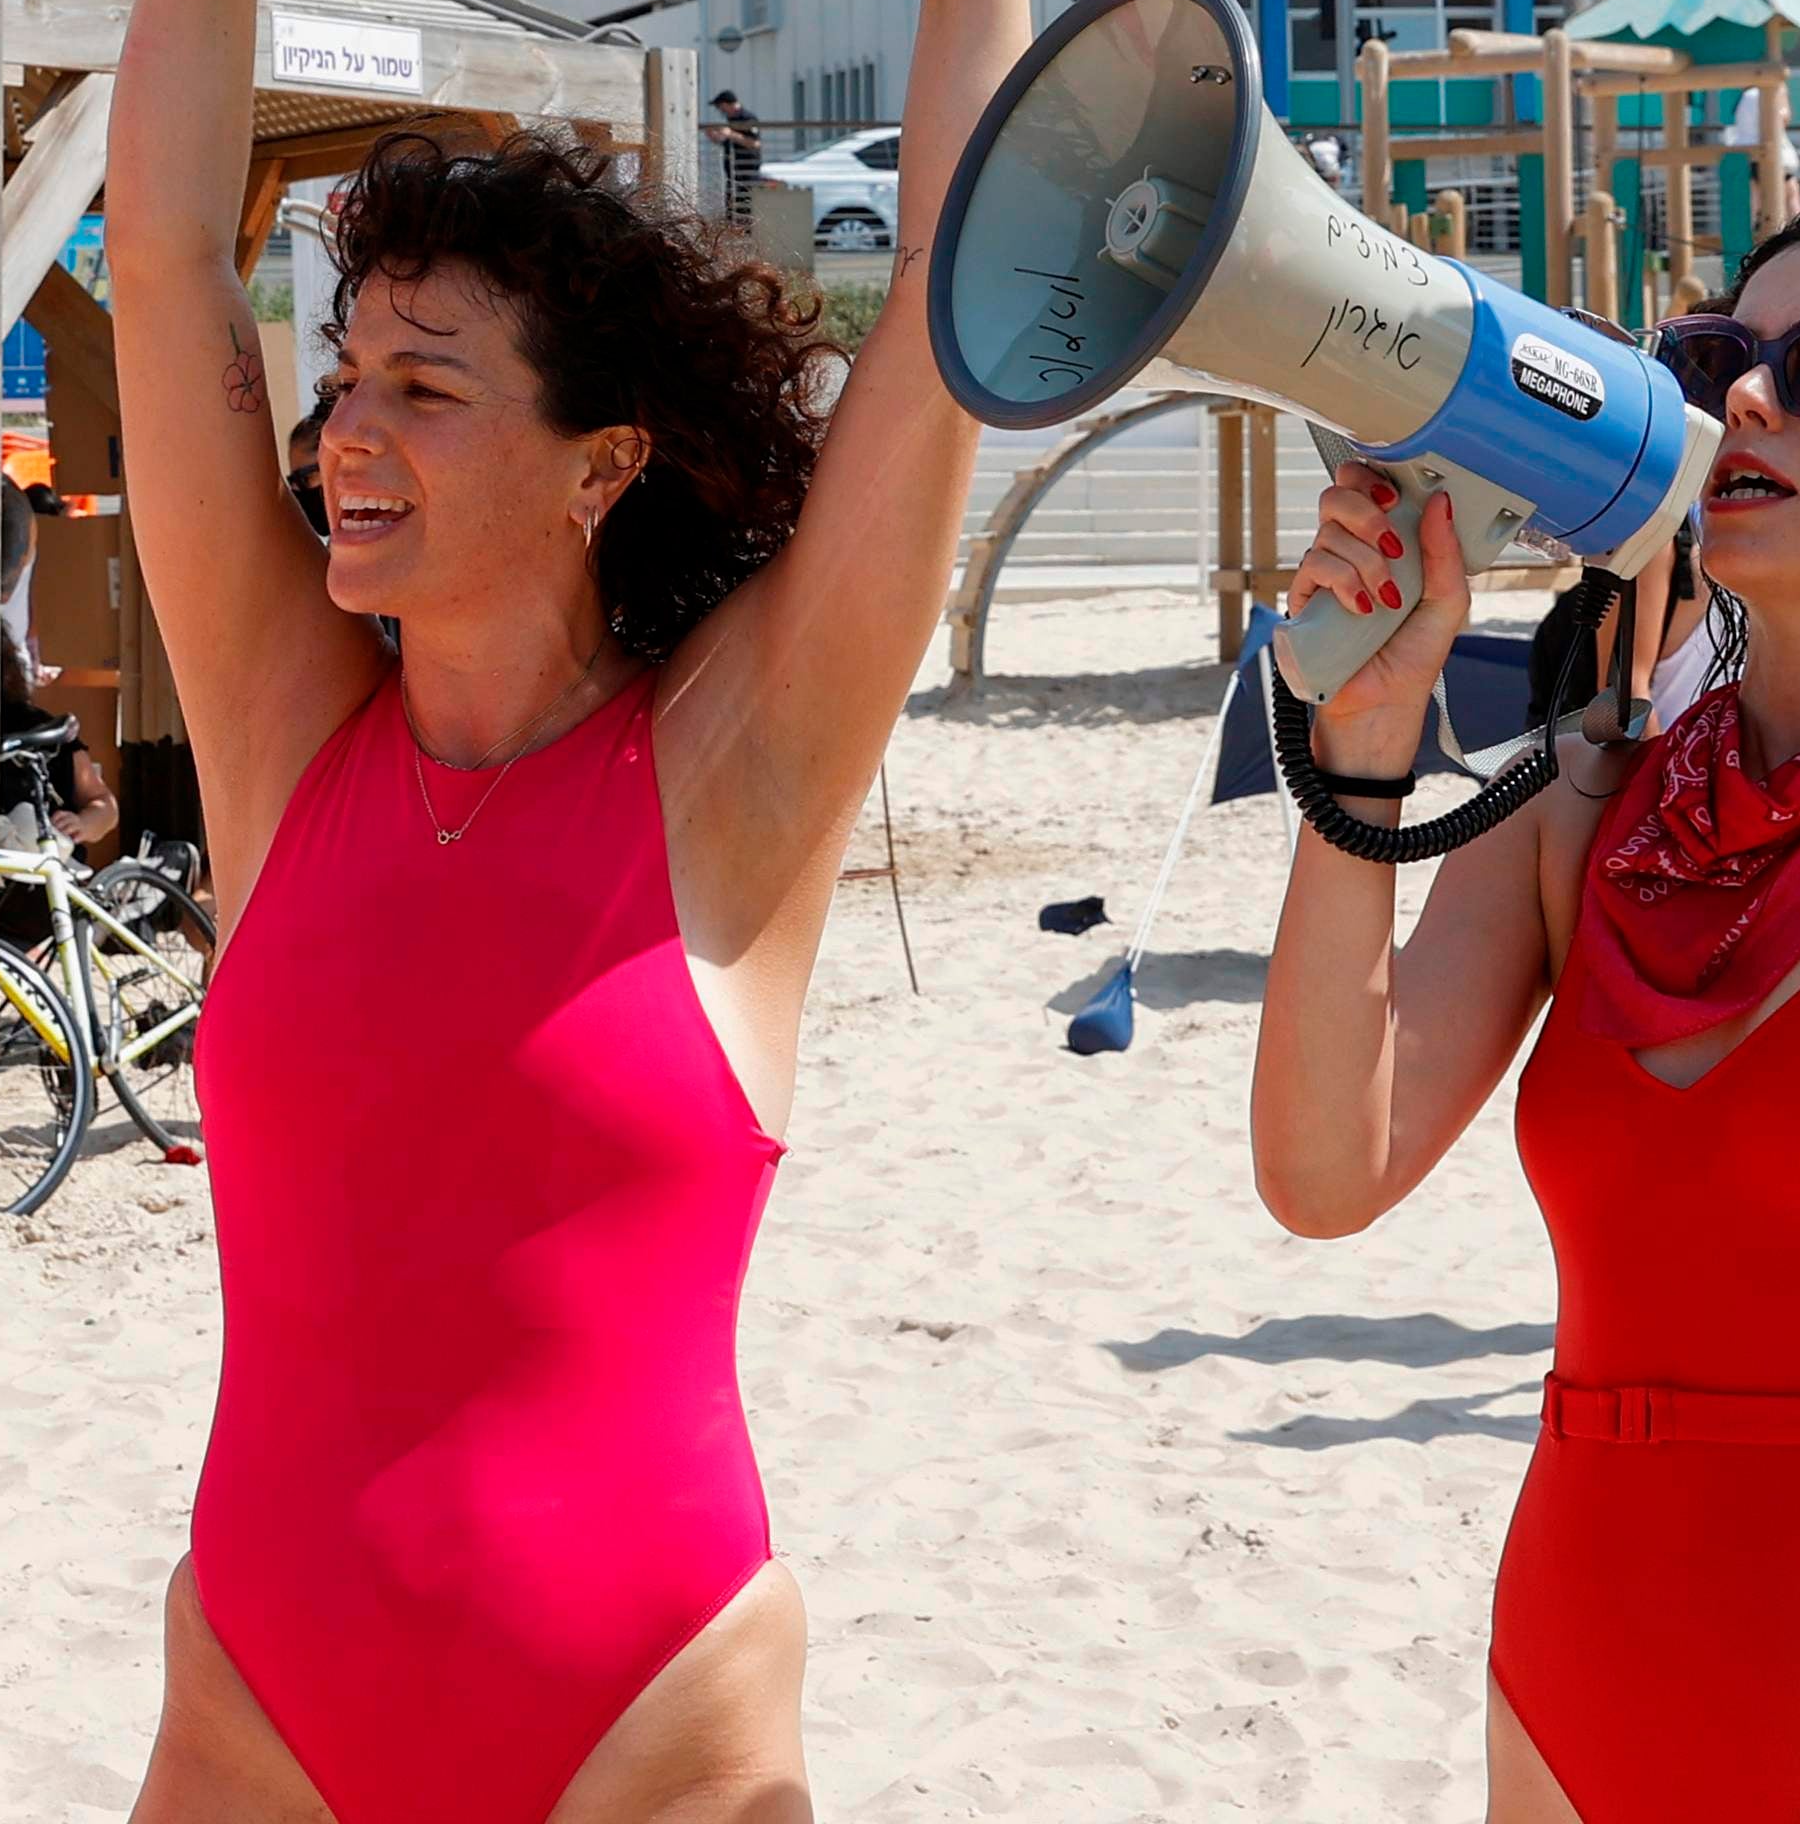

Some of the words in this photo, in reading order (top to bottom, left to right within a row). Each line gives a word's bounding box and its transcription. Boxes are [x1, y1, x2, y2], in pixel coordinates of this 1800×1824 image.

[283, 45, 336, 73] הניקיון
[342, 46, 365, 72] על
[371, 56, 413, 78] שמור
[1519, 366, 1591, 415] MEGAPHONE
